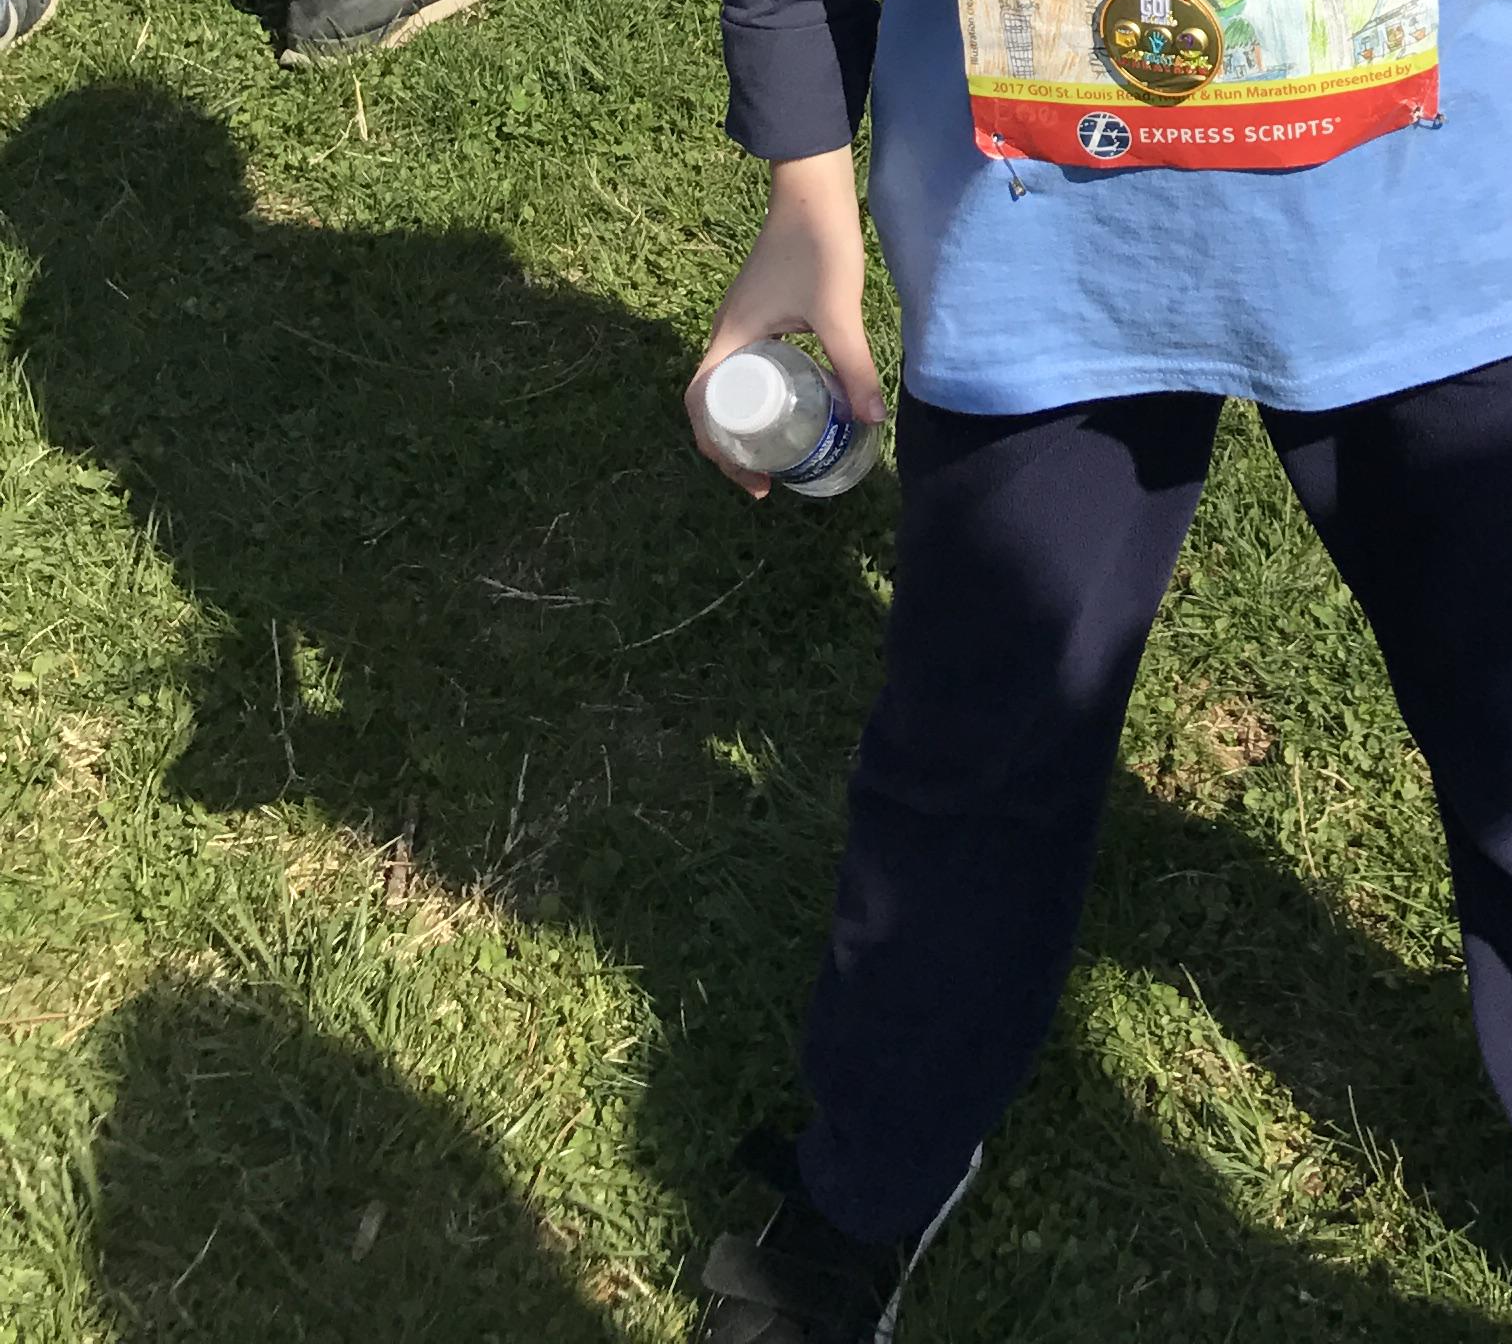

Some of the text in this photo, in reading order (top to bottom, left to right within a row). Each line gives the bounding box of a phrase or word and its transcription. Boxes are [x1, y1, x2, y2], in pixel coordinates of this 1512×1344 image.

[967, 18, 978, 66] Illustration
[993, 82, 1024, 96] 2017
[1028, 84, 1052, 98] GO!
[1056, 88, 1073, 100] St.
[1076, 89, 1113, 102] Louis
[1200, 89, 1210, 100] &
[1214, 88, 1242, 101] Run
[1246, 82, 1316, 100] Marathon
[1320, 67, 1392, 93] presented
[1395, 62, 1412, 77] by
[1140, 118, 1334, 144] EXPRESS SCRIPTS
